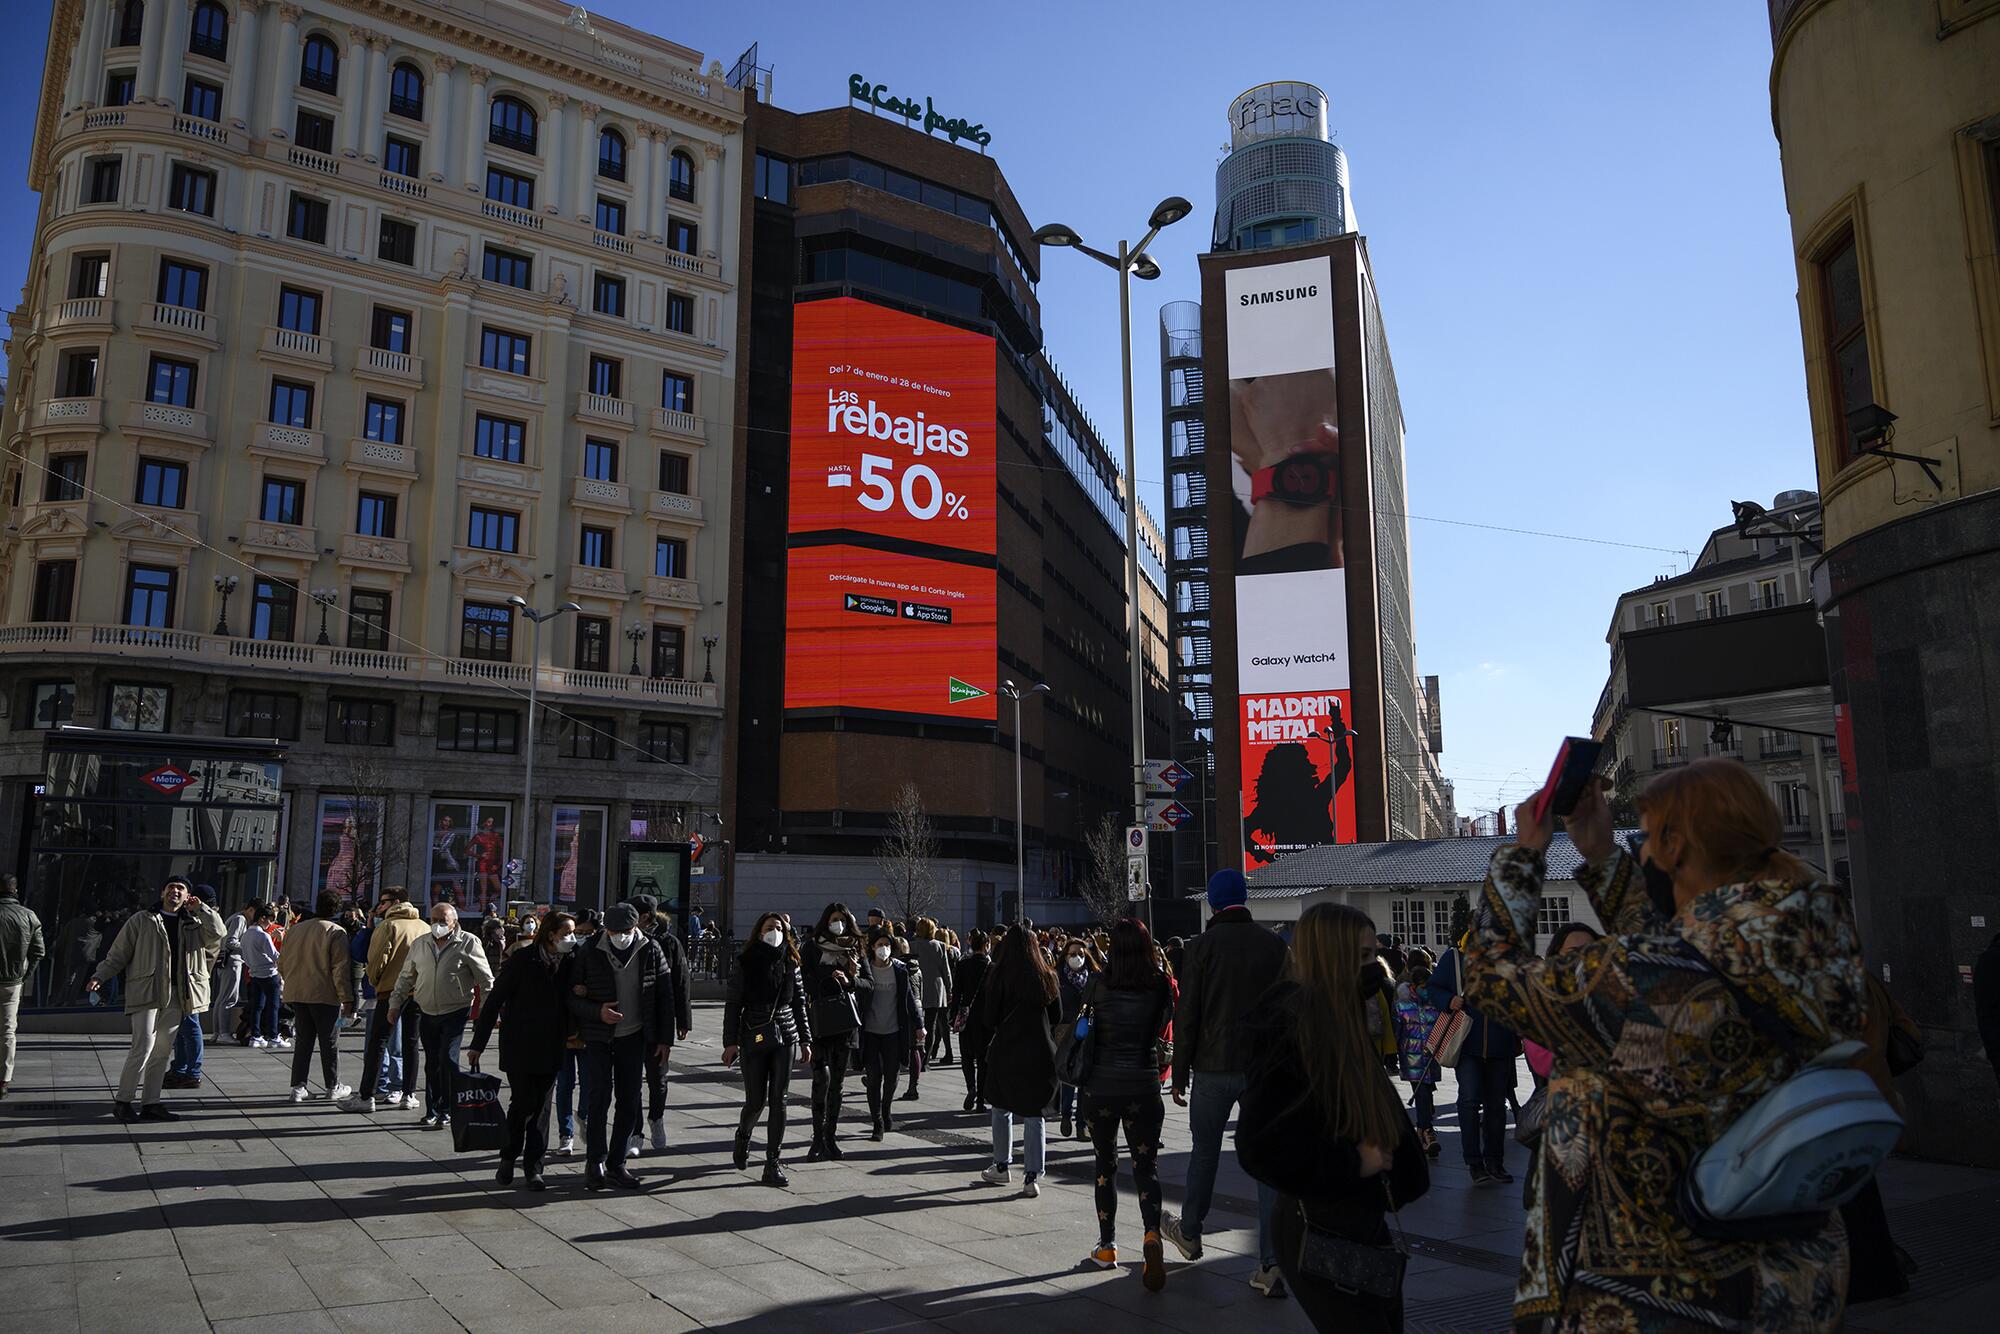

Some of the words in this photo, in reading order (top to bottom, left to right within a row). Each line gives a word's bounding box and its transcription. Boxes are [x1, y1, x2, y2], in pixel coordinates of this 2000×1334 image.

[1238, 95, 1319, 130] fnac
[1240, 285, 1318, 306] SAMSUNG
[829, 364, 844, 375] Del
[846, 365, 852, 374] 7
[853, 367, 864, 376] de
[866, 371, 889, 383] enero
[890, 375, 898, 385] al
[899, 378, 910, 388] 28
[911, 381, 922, 391] de
[923, 383, 951, 398] febrero
[828, 388, 859, 404] Las
[828, 400, 969, 457] rebajas
[828, 465, 852, 473] HASTA
[868, 577, 875, 586] la
[876, 579, 896, 589] nueva
[897, 582, 910, 592] app
[910, 584, 920, 592] de
[928, 587, 946, 596] Corte
[860, 602, 882, 613] Google
[882, 605, 895, 615] Play
[917, 611, 931, 620] App
[931, 613, 948, 621] Store
[1251, 655, 1291, 668] Galaxy
[1293, 652, 1336, 664] Watch4
[155, 775, 182, 785] Metro
[33, 784, 46, 794] PE
